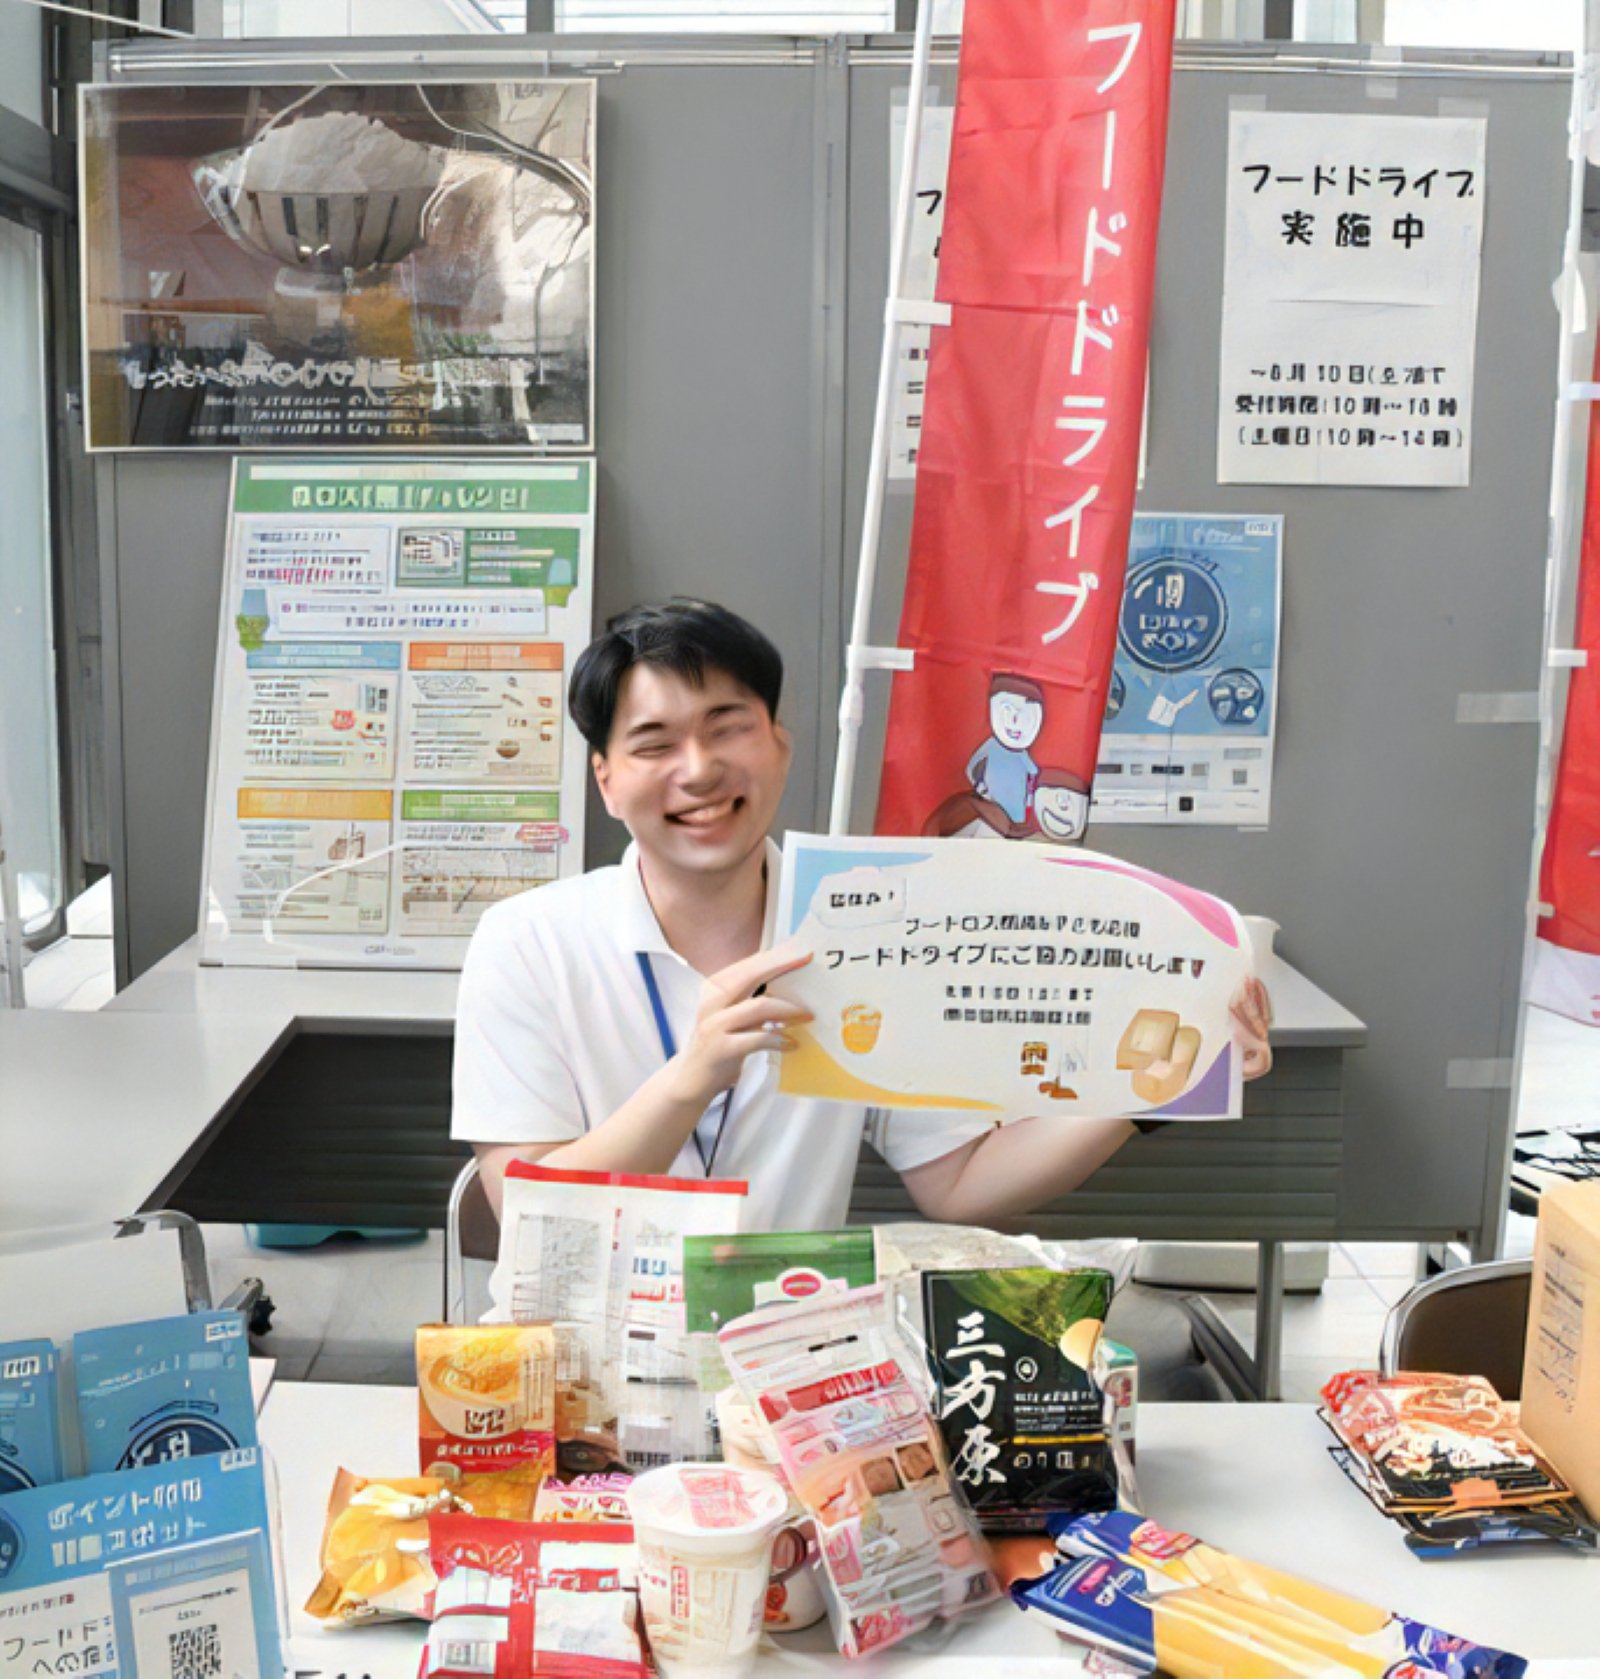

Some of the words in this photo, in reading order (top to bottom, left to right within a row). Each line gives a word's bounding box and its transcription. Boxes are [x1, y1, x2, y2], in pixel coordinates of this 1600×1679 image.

[1281, 210, 1425, 250] 実施中
[1034, 22, 1143, 645] フードドライブ
[940, 1311, 1008, 1487] 三方原
